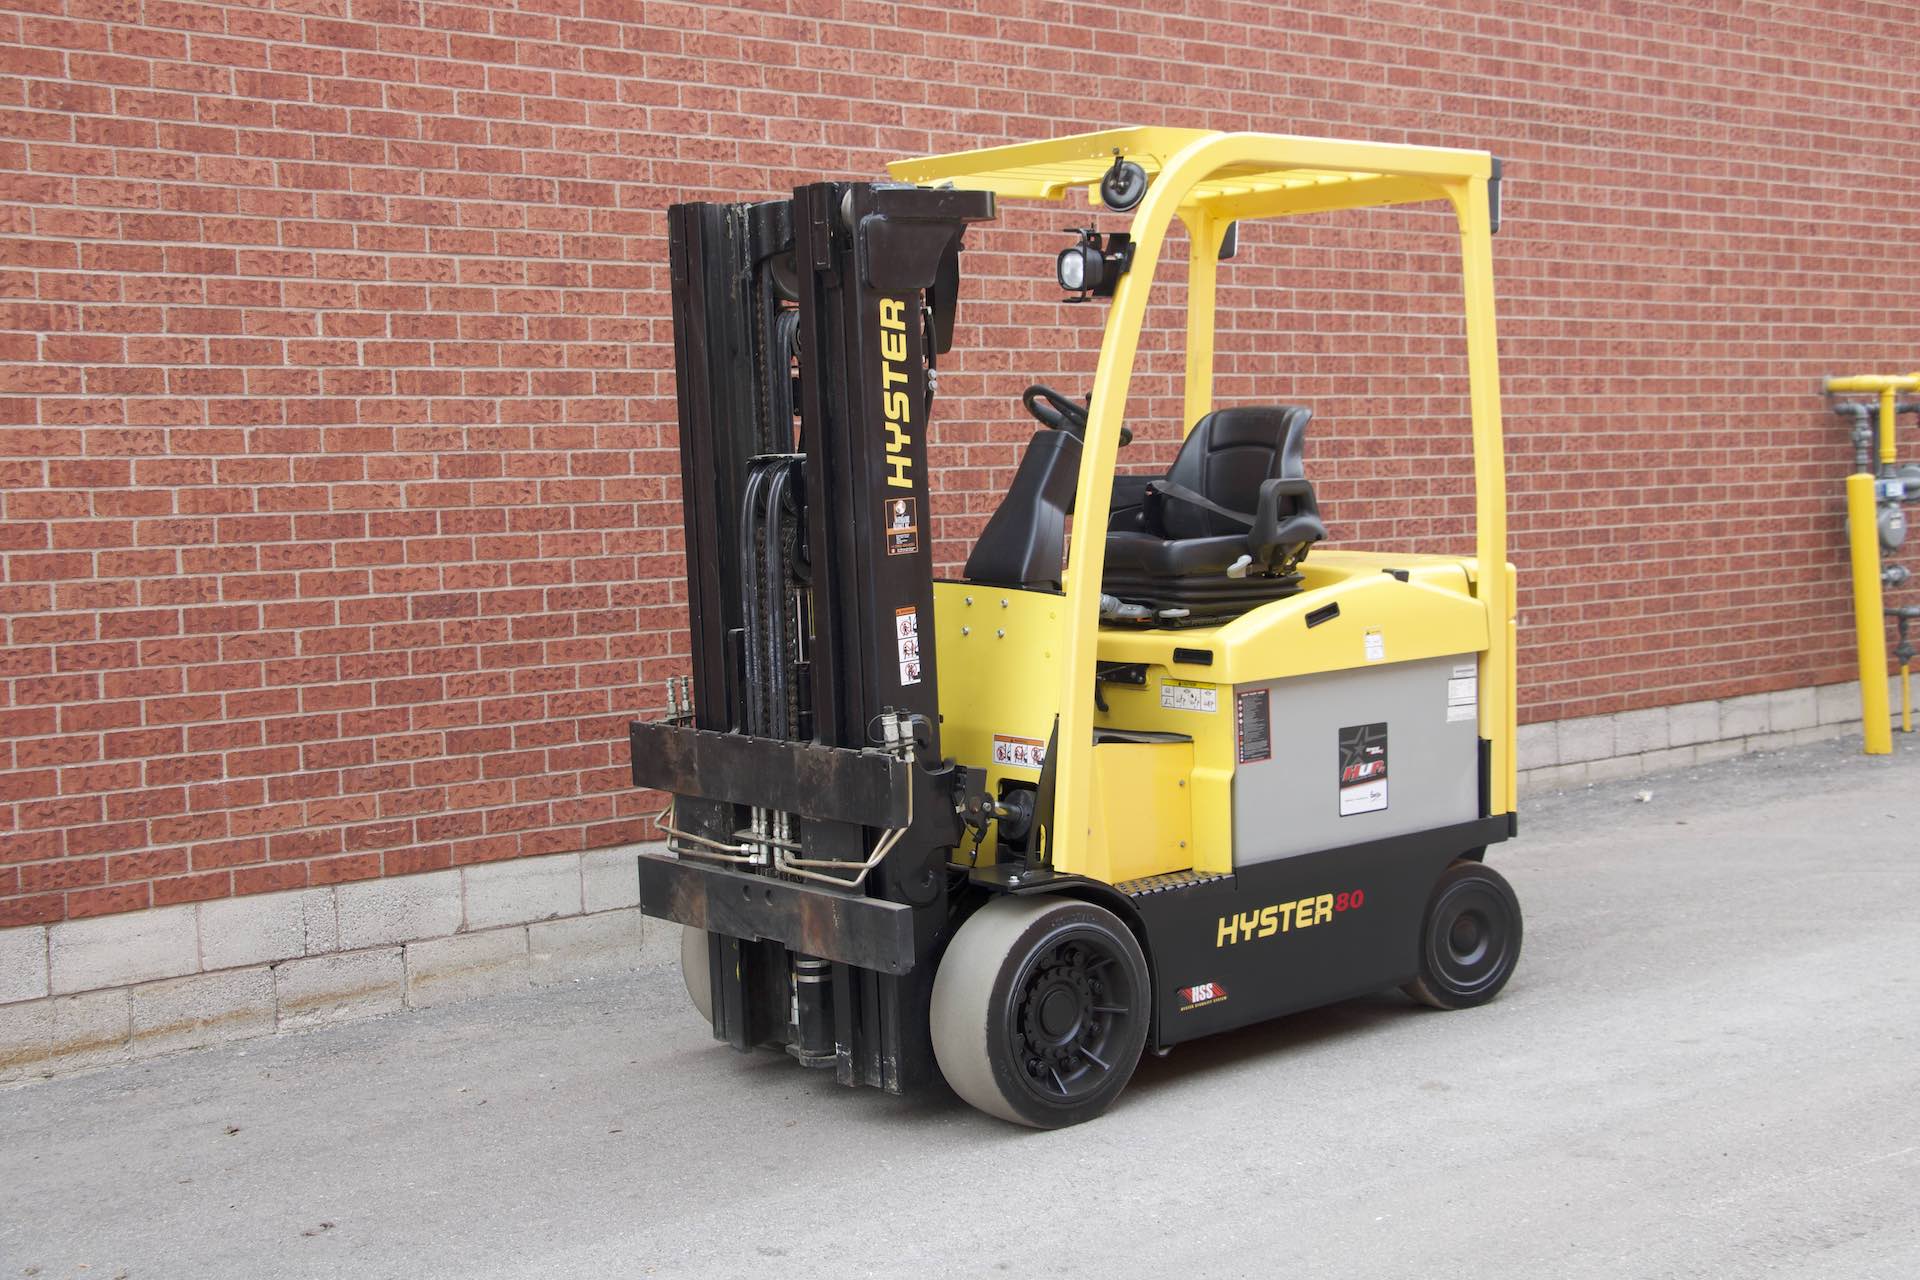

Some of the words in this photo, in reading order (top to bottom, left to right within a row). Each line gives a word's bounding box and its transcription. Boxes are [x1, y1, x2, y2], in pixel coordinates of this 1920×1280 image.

[880, 298, 912, 488] HYSTER
[1217, 894, 1333, 947] HYSTER
[1335, 890, 1364, 911] 80
[1191, 983, 1213, 1003] HSS
